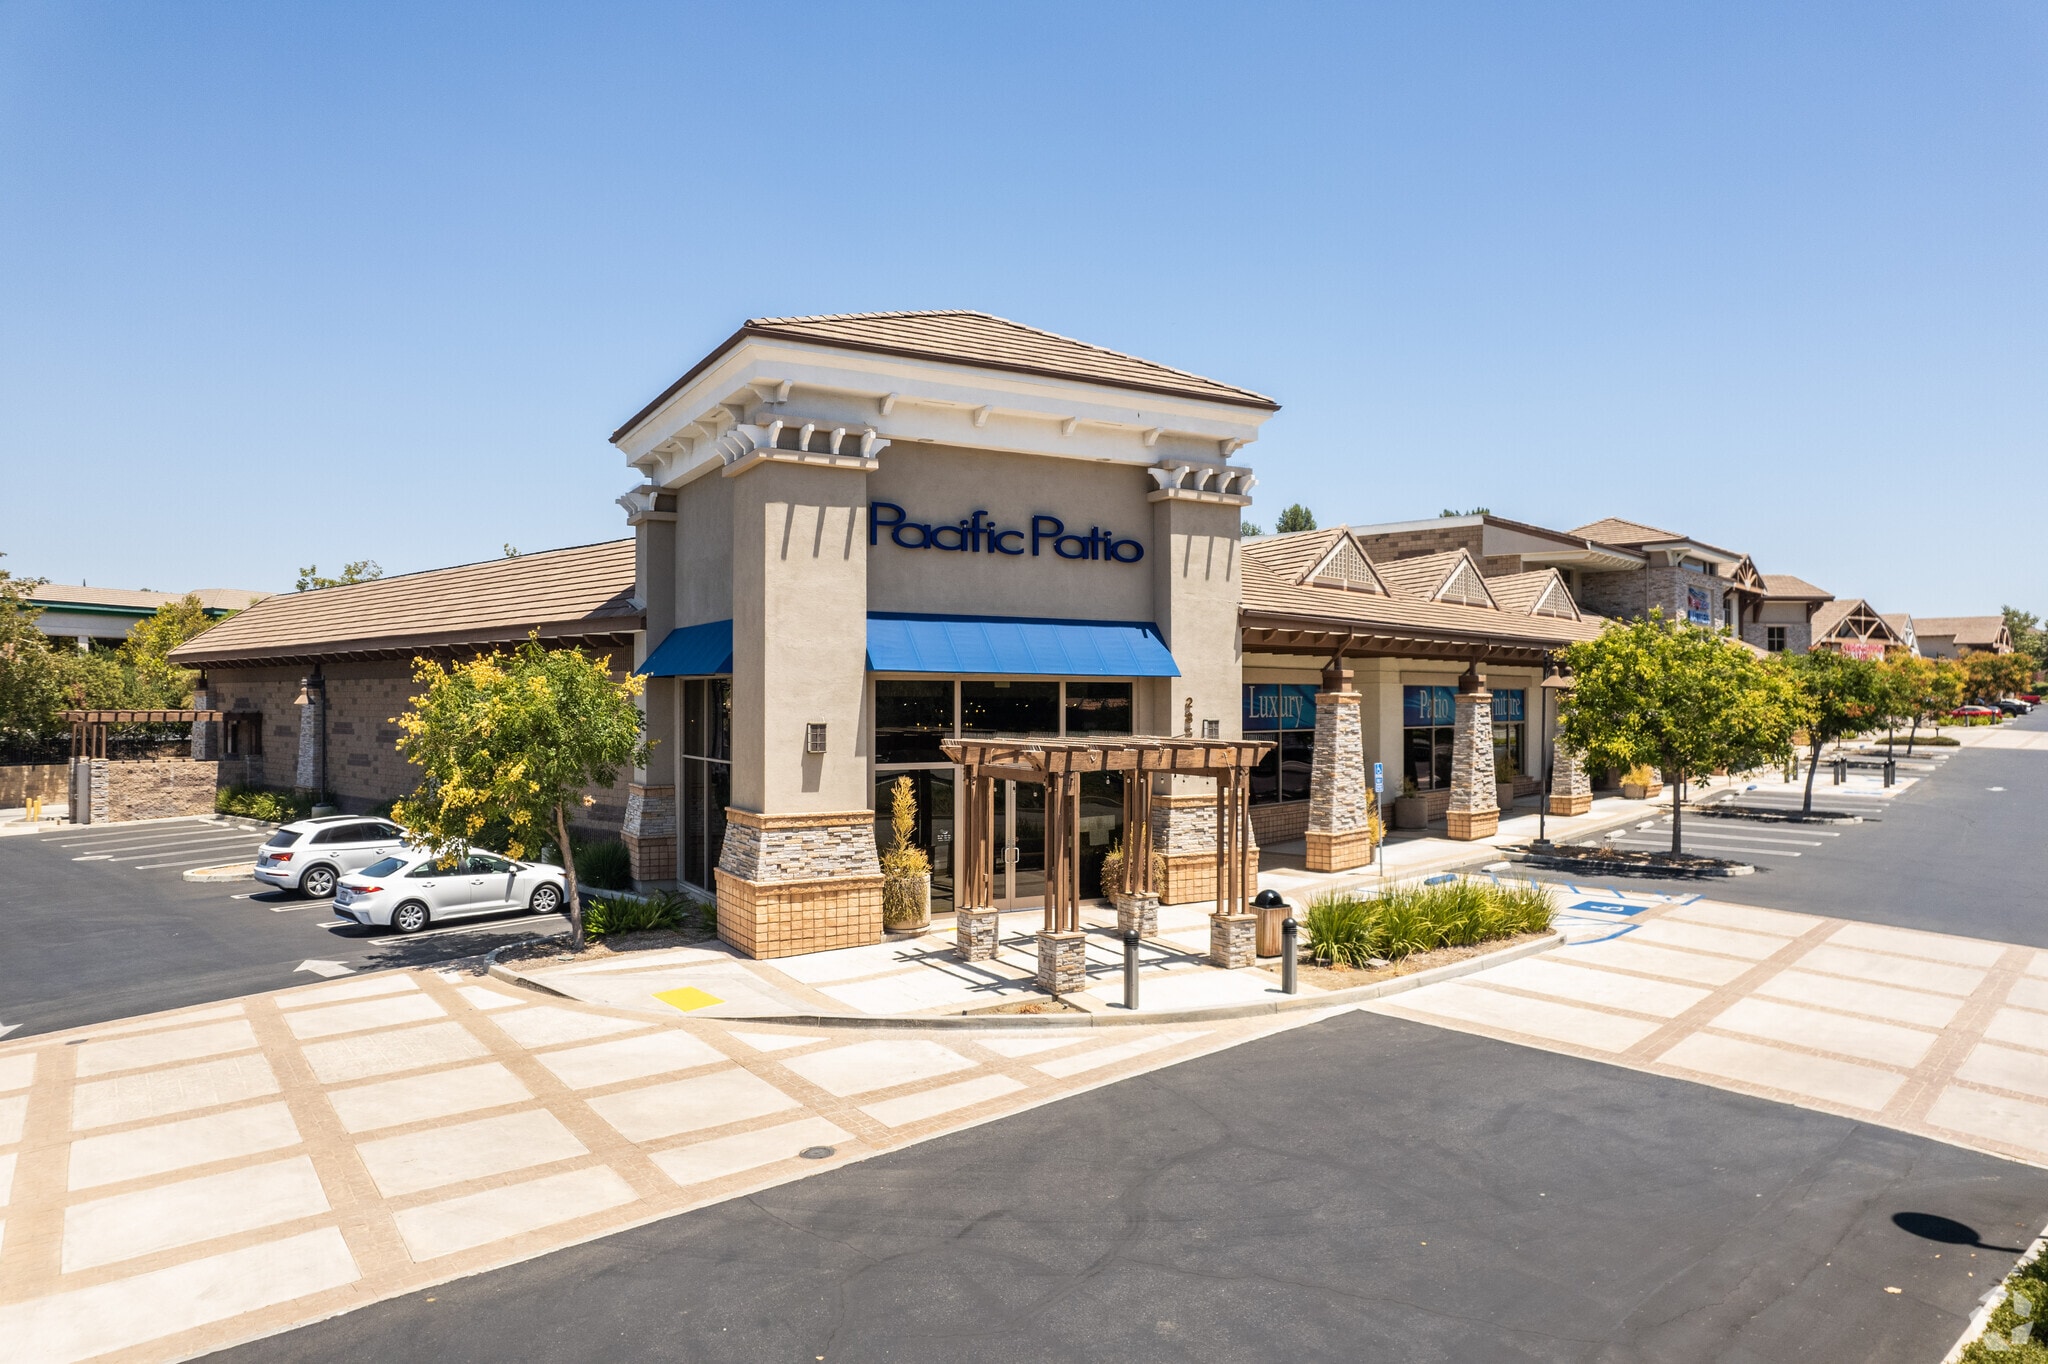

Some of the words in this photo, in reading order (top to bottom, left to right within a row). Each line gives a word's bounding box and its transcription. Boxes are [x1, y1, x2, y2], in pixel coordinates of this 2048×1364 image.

[870, 501, 1025, 555] Pacific
[1032, 515, 1144, 563] Patio
[1248, 685, 1304, 728] Luxury
[1420, 690, 1449, 718] Patio
